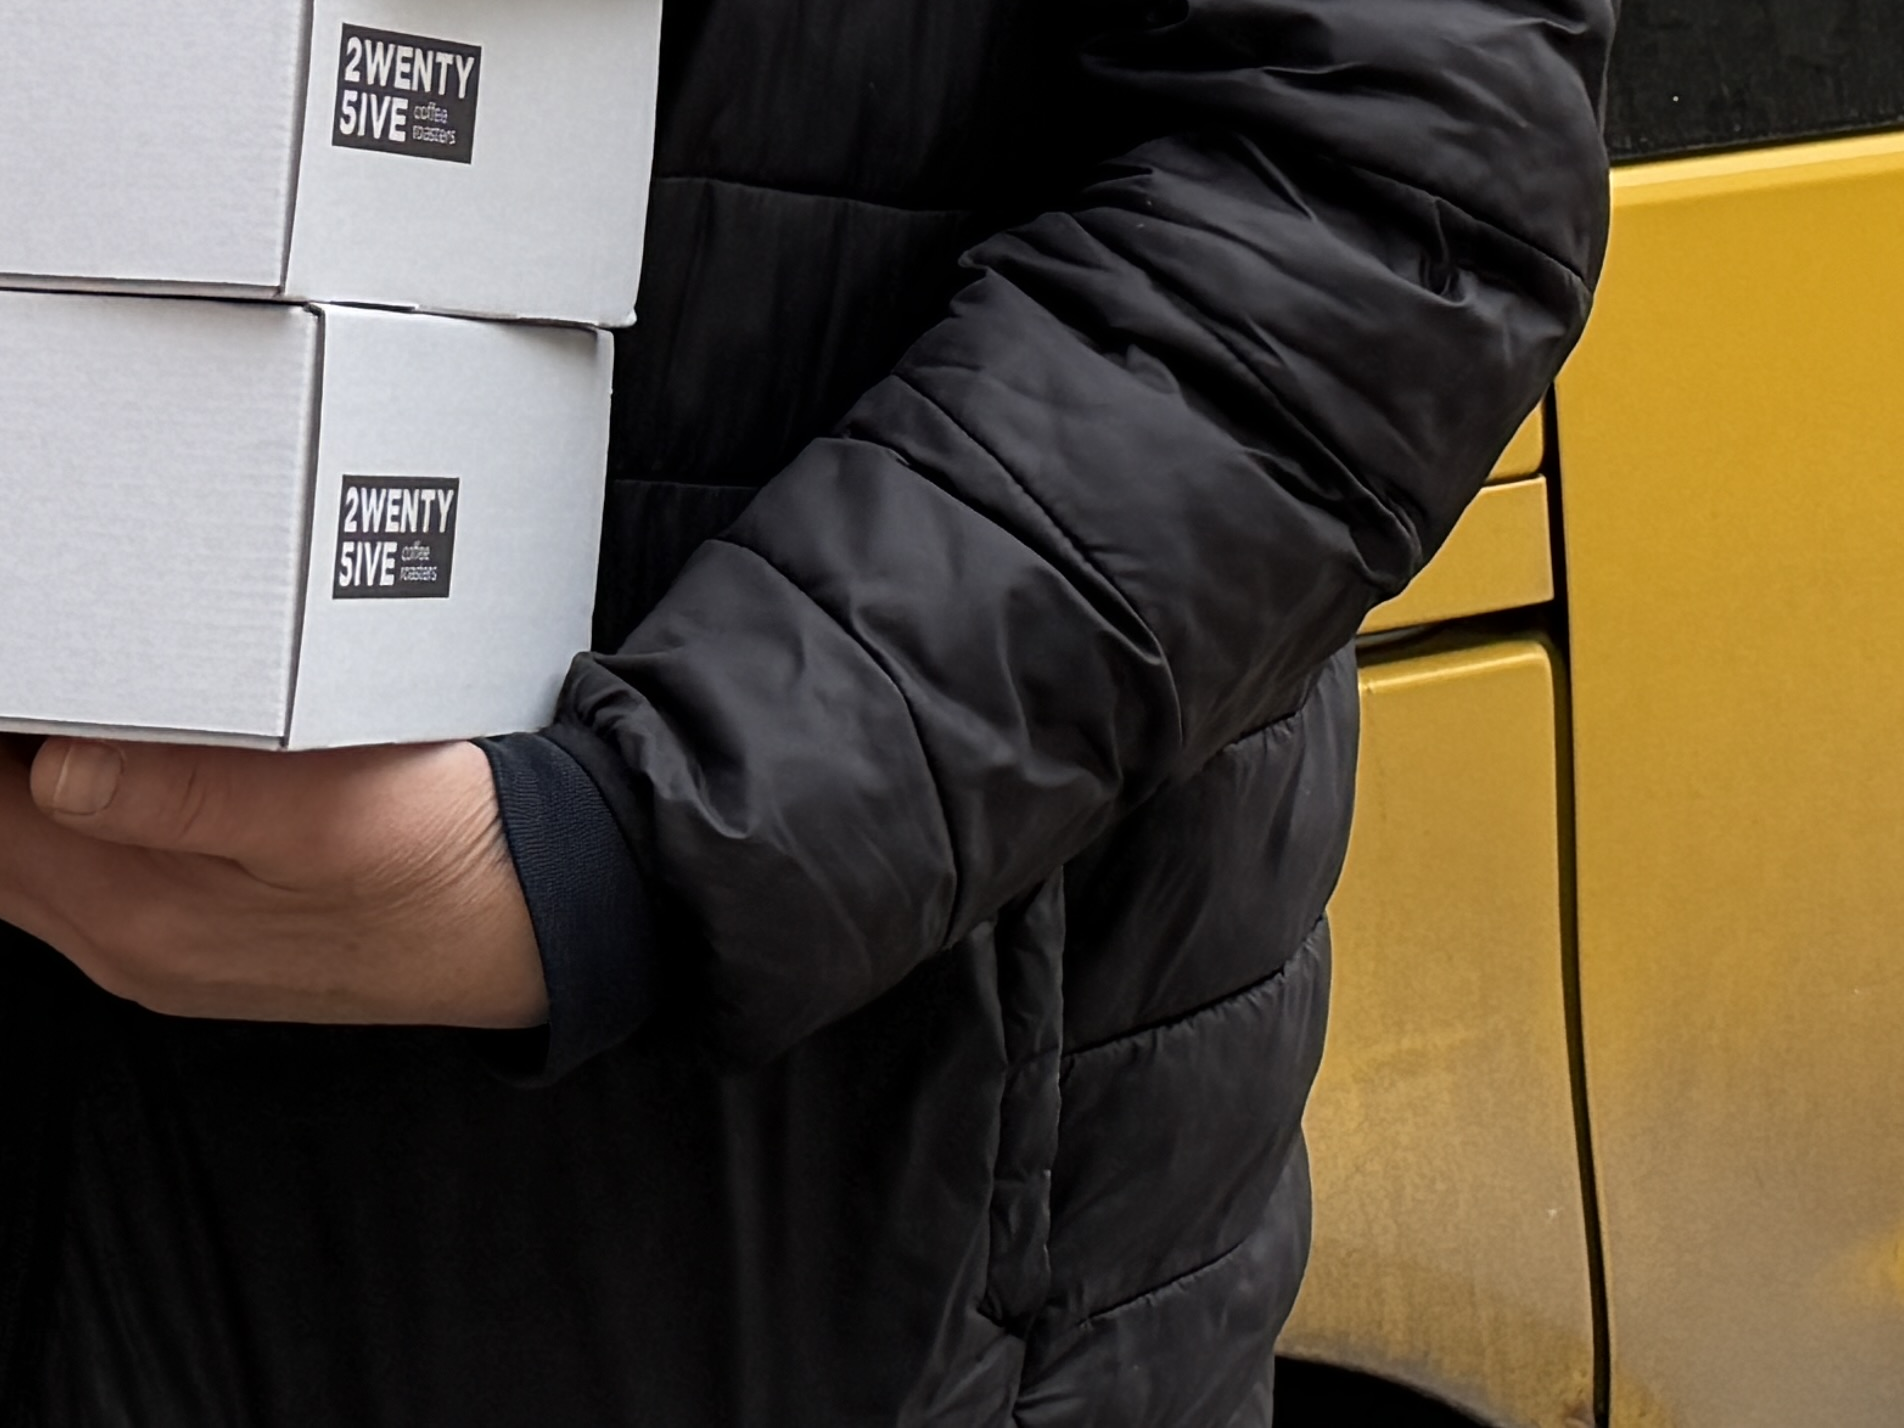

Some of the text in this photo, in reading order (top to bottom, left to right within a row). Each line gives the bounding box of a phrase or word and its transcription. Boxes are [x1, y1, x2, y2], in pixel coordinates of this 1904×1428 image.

[344, 36, 475, 99] 2WENTY
[339, 89, 409, 142] 5IVE
[343, 486, 454, 533] 2WENTY
[339, 541, 398, 587] 5IVE
